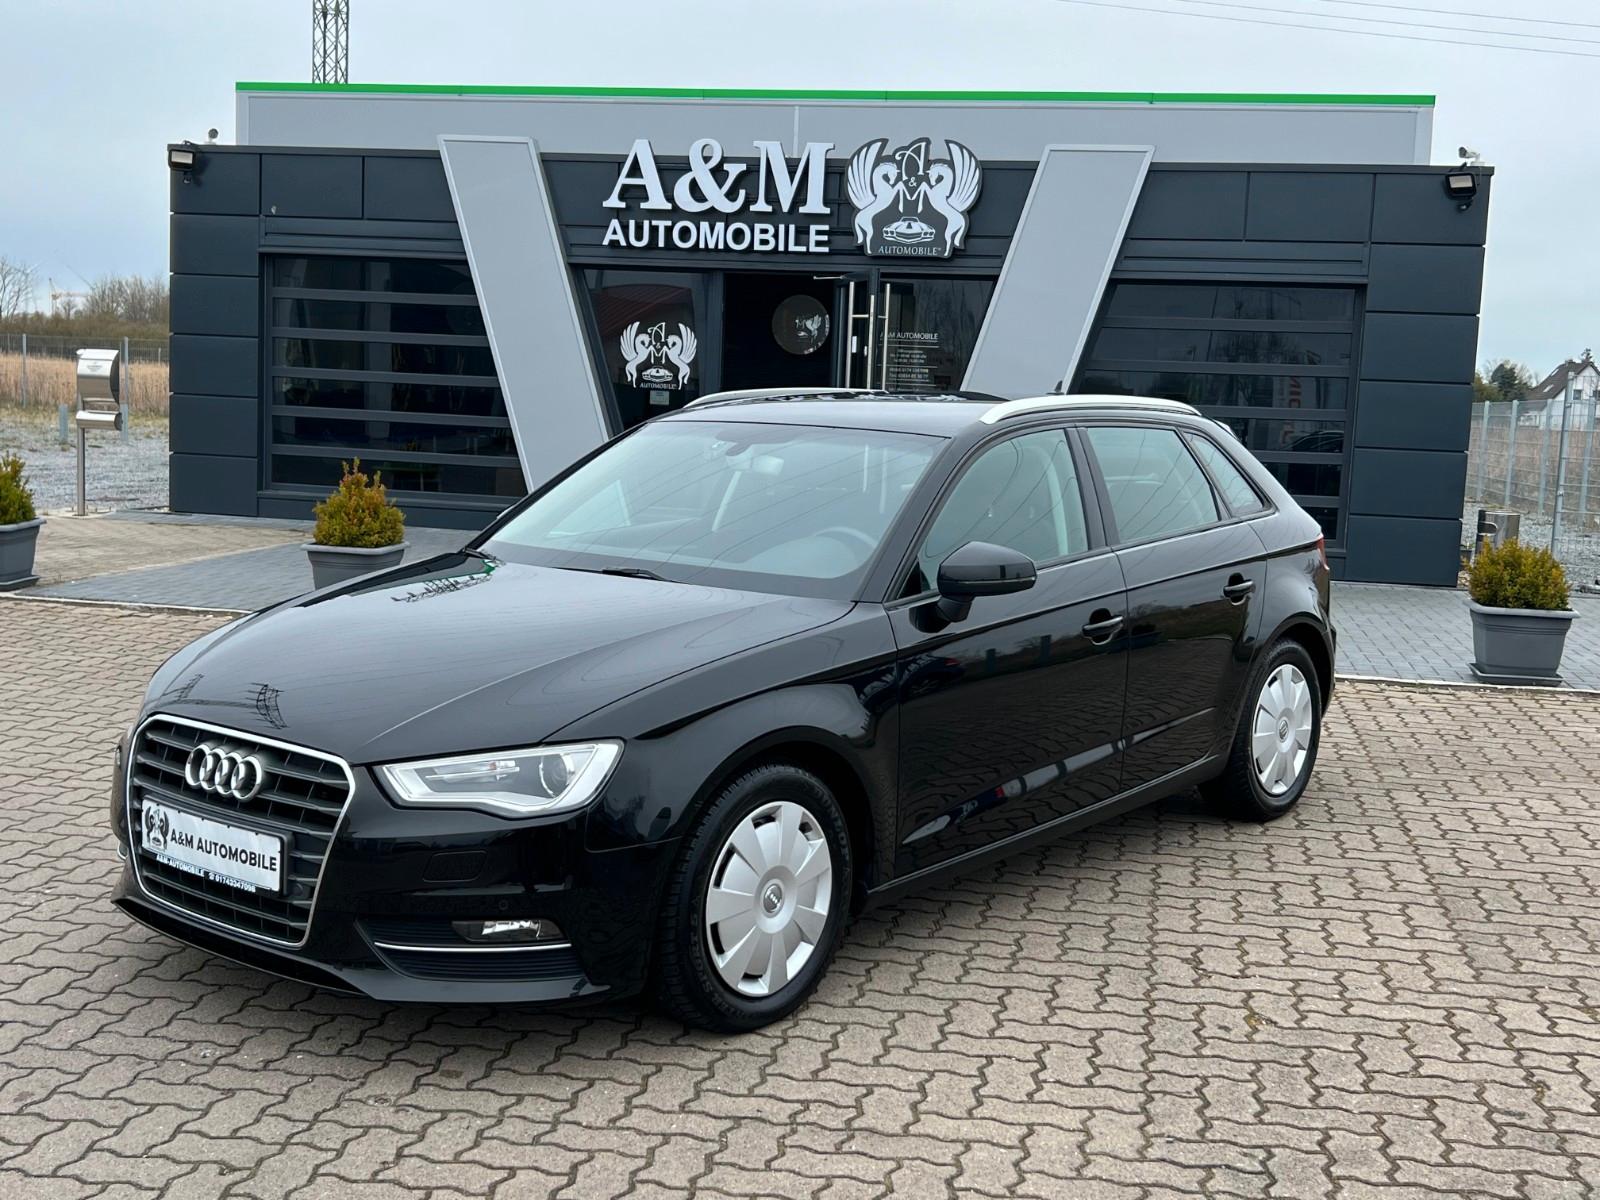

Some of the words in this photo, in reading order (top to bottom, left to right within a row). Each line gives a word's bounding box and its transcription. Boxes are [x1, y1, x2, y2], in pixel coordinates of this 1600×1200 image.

[602, 138, 836, 215] A&M
[602, 218, 831, 253] AUTOMOBILE
[896, 332, 939, 340] AUTOMOBILE
[170, 828, 194, 849] A&M
[196, 837, 278, 872] AUTOMOBILE
